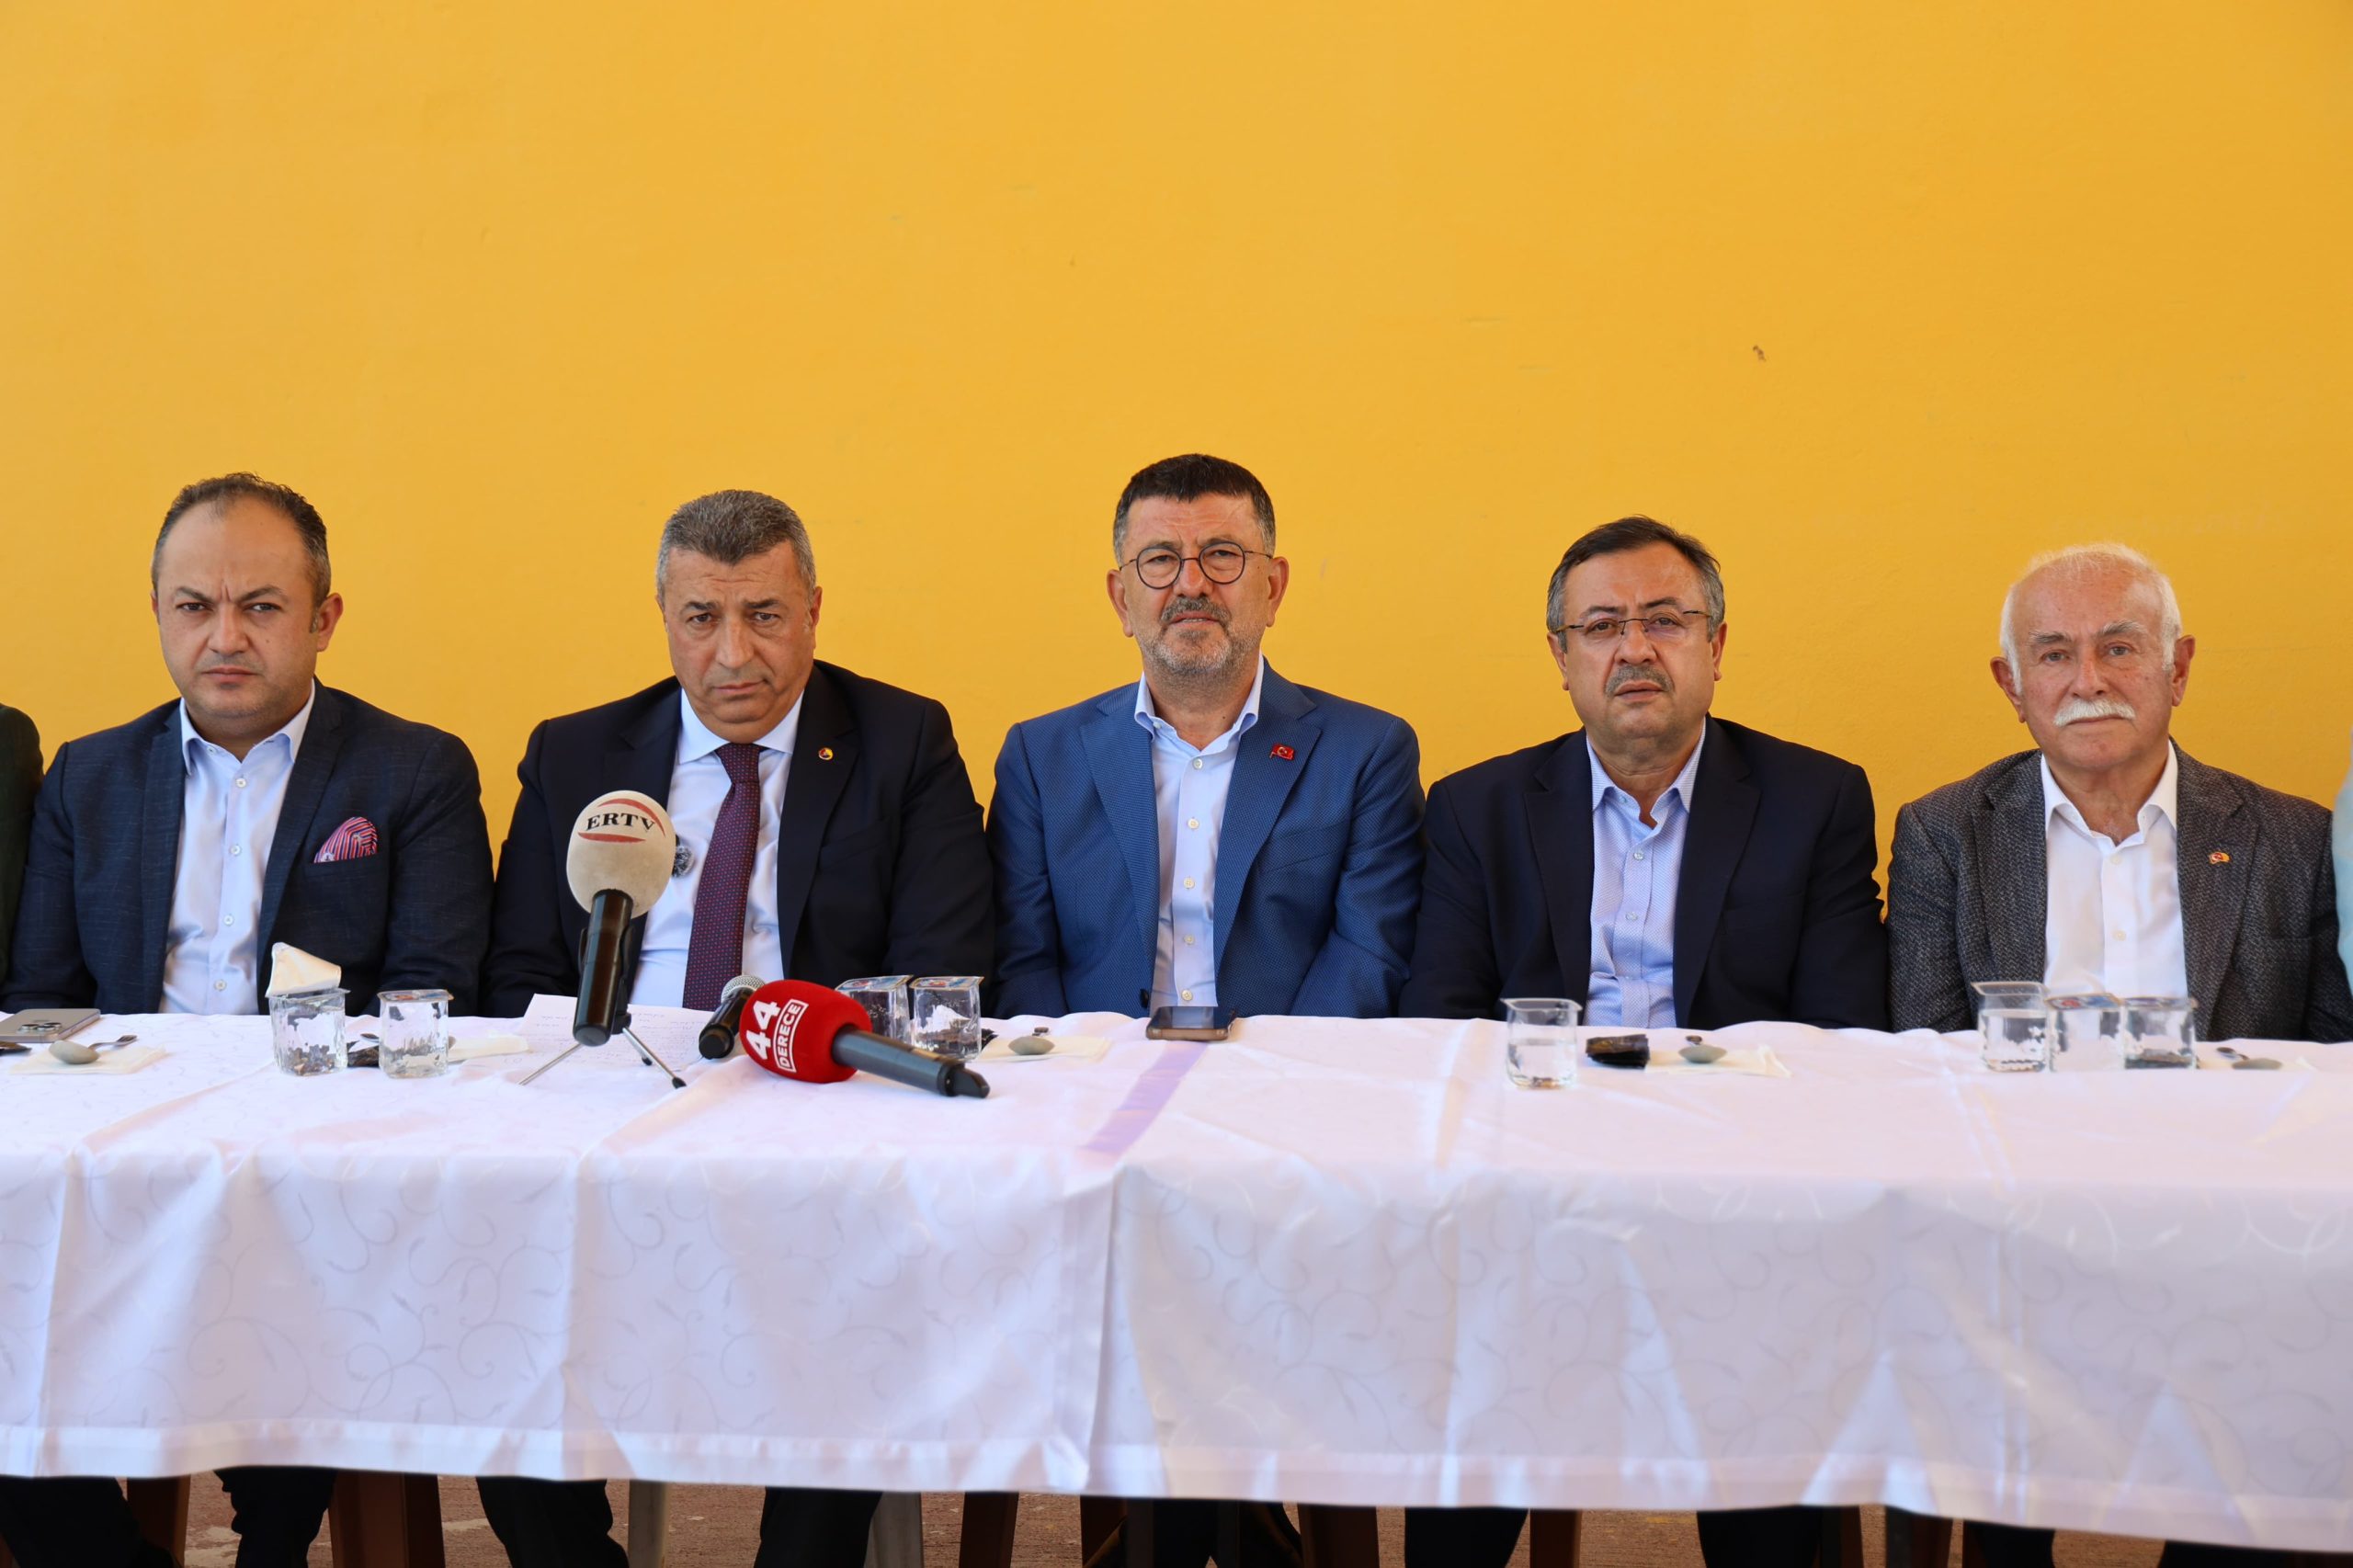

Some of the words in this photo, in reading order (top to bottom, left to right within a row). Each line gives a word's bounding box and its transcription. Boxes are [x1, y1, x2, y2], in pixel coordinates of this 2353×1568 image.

[585, 812, 655, 831] ERTV
[745, 1000, 781, 1060] 44
[777, 1003, 801, 1068] DERECE
